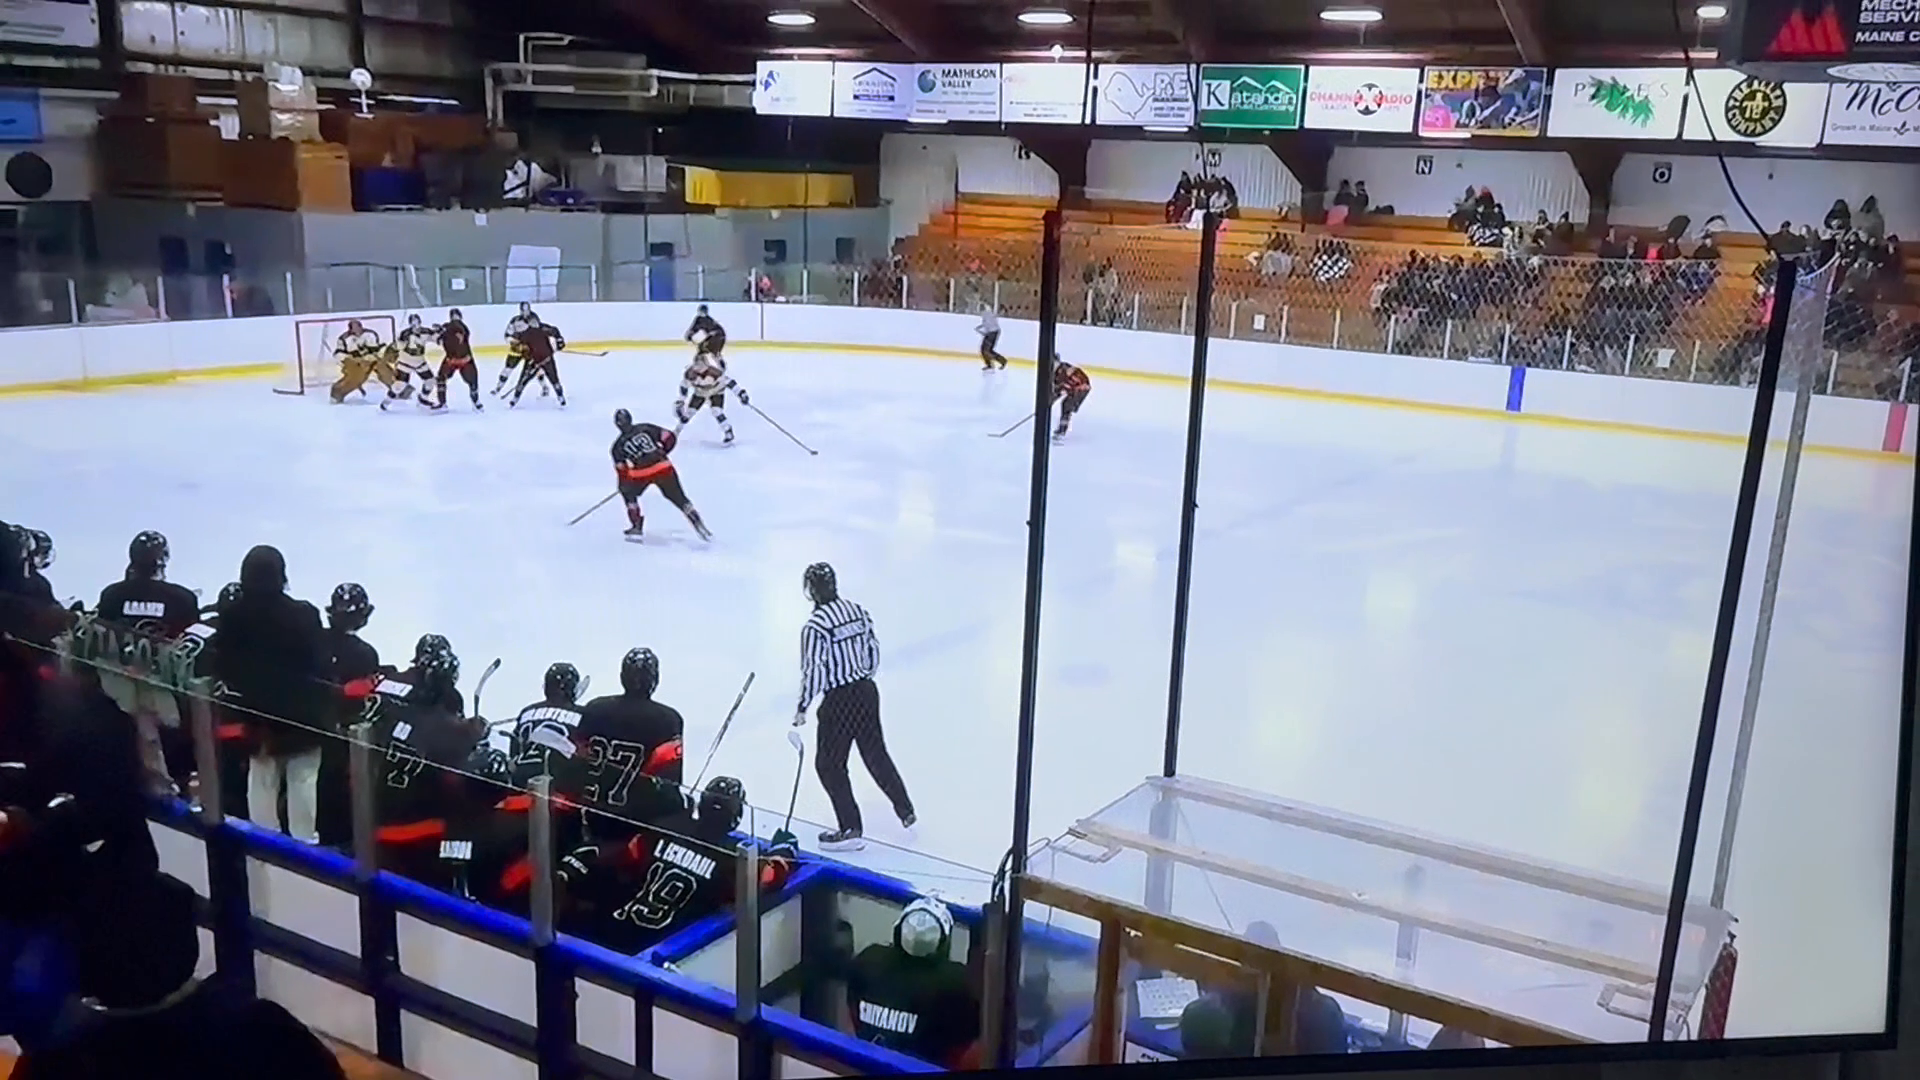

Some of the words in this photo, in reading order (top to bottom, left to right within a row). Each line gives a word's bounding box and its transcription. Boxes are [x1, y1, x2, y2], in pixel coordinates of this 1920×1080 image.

[1854, 31, 1906, 43] MAINE
[941, 68, 997, 79] MATHESON
[941, 80, 972, 89] VALLEY
[1418, 159, 1431, 175] N
